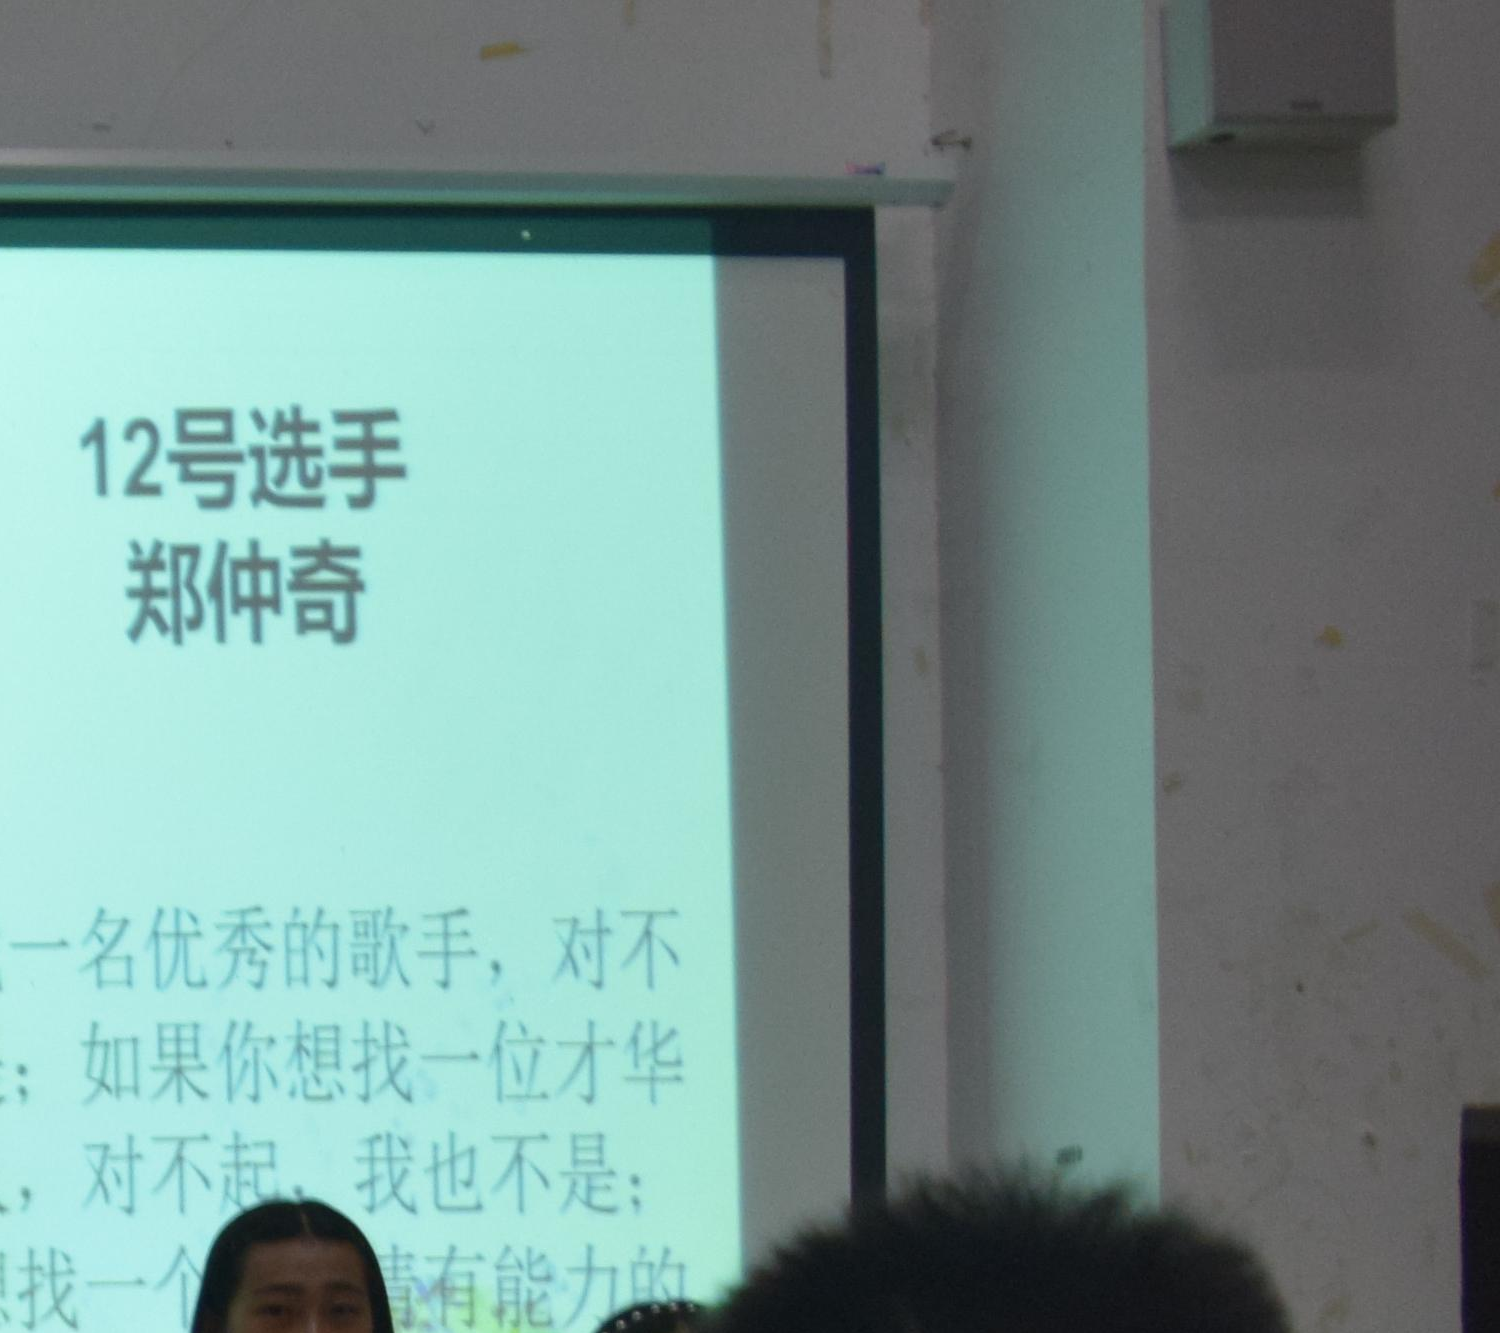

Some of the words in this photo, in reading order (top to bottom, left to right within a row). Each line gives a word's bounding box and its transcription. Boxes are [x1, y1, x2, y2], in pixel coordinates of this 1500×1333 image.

[79, 402, 408, 510] 12号选手
[124, 537, 366, 646] 郑仲奇
